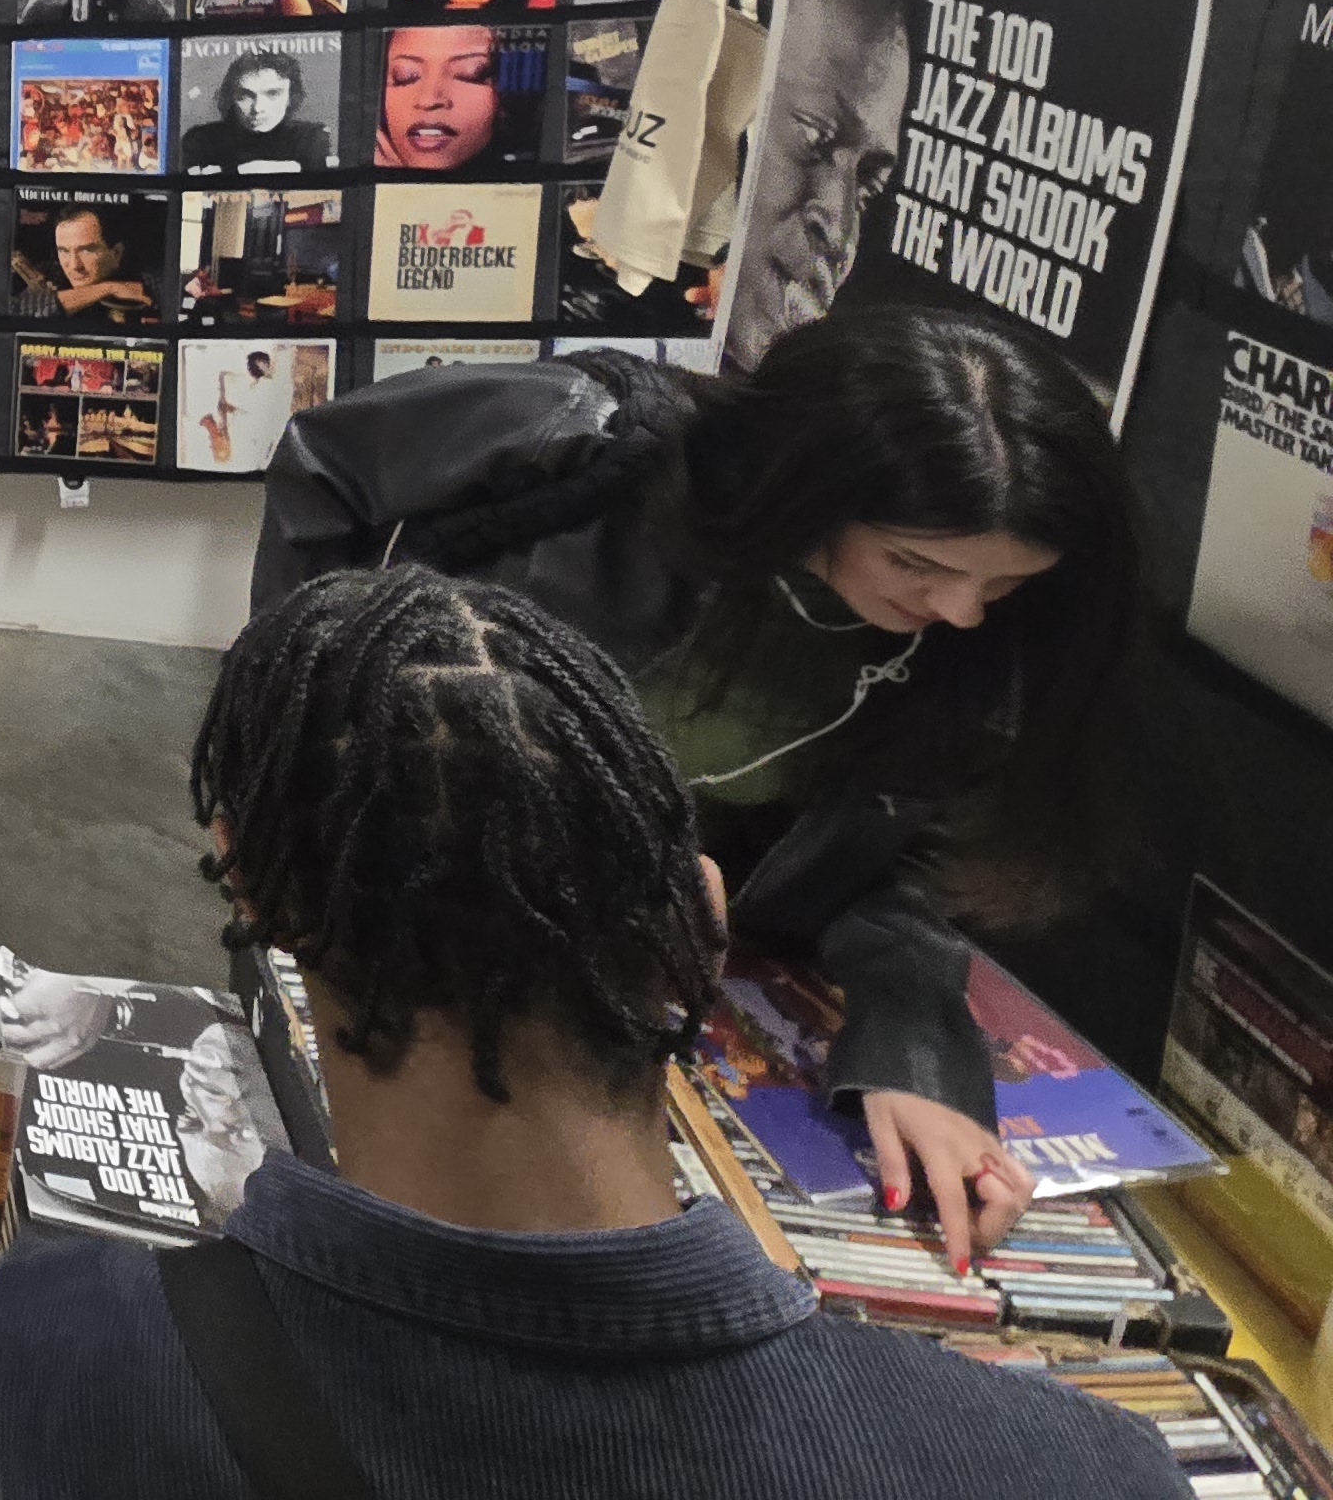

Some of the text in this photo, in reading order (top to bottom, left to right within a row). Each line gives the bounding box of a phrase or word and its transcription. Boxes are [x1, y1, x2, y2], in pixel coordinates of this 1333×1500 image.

[182, 40, 230, 58] JACO
[236, 36, 342, 55] PASTORIUS
[988, 10, 1054, 90] 100
[910, 61, 1152, 204] JAZZ ALBUMS
[904, 128, 1116, 273] THAT SHOOK
[400, 223, 429, 245] BIX
[396, 269, 455, 290] LEGEND
[398, 246, 517, 269] BEIDERBECKE
[891, 193, 1082, 339] THE WORLD
[1221, 405, 1296, 456] MASTER
[1274, 403, 1307, 436] THE
[38, 1073, 170, 1118] THE WORLD
[33, 1099, 178, 1146] THAT SHOOK
[26, 1125, 182, 1176] JAZZ ALBUMS
[98, 1165, 195, 1207] THE 100
